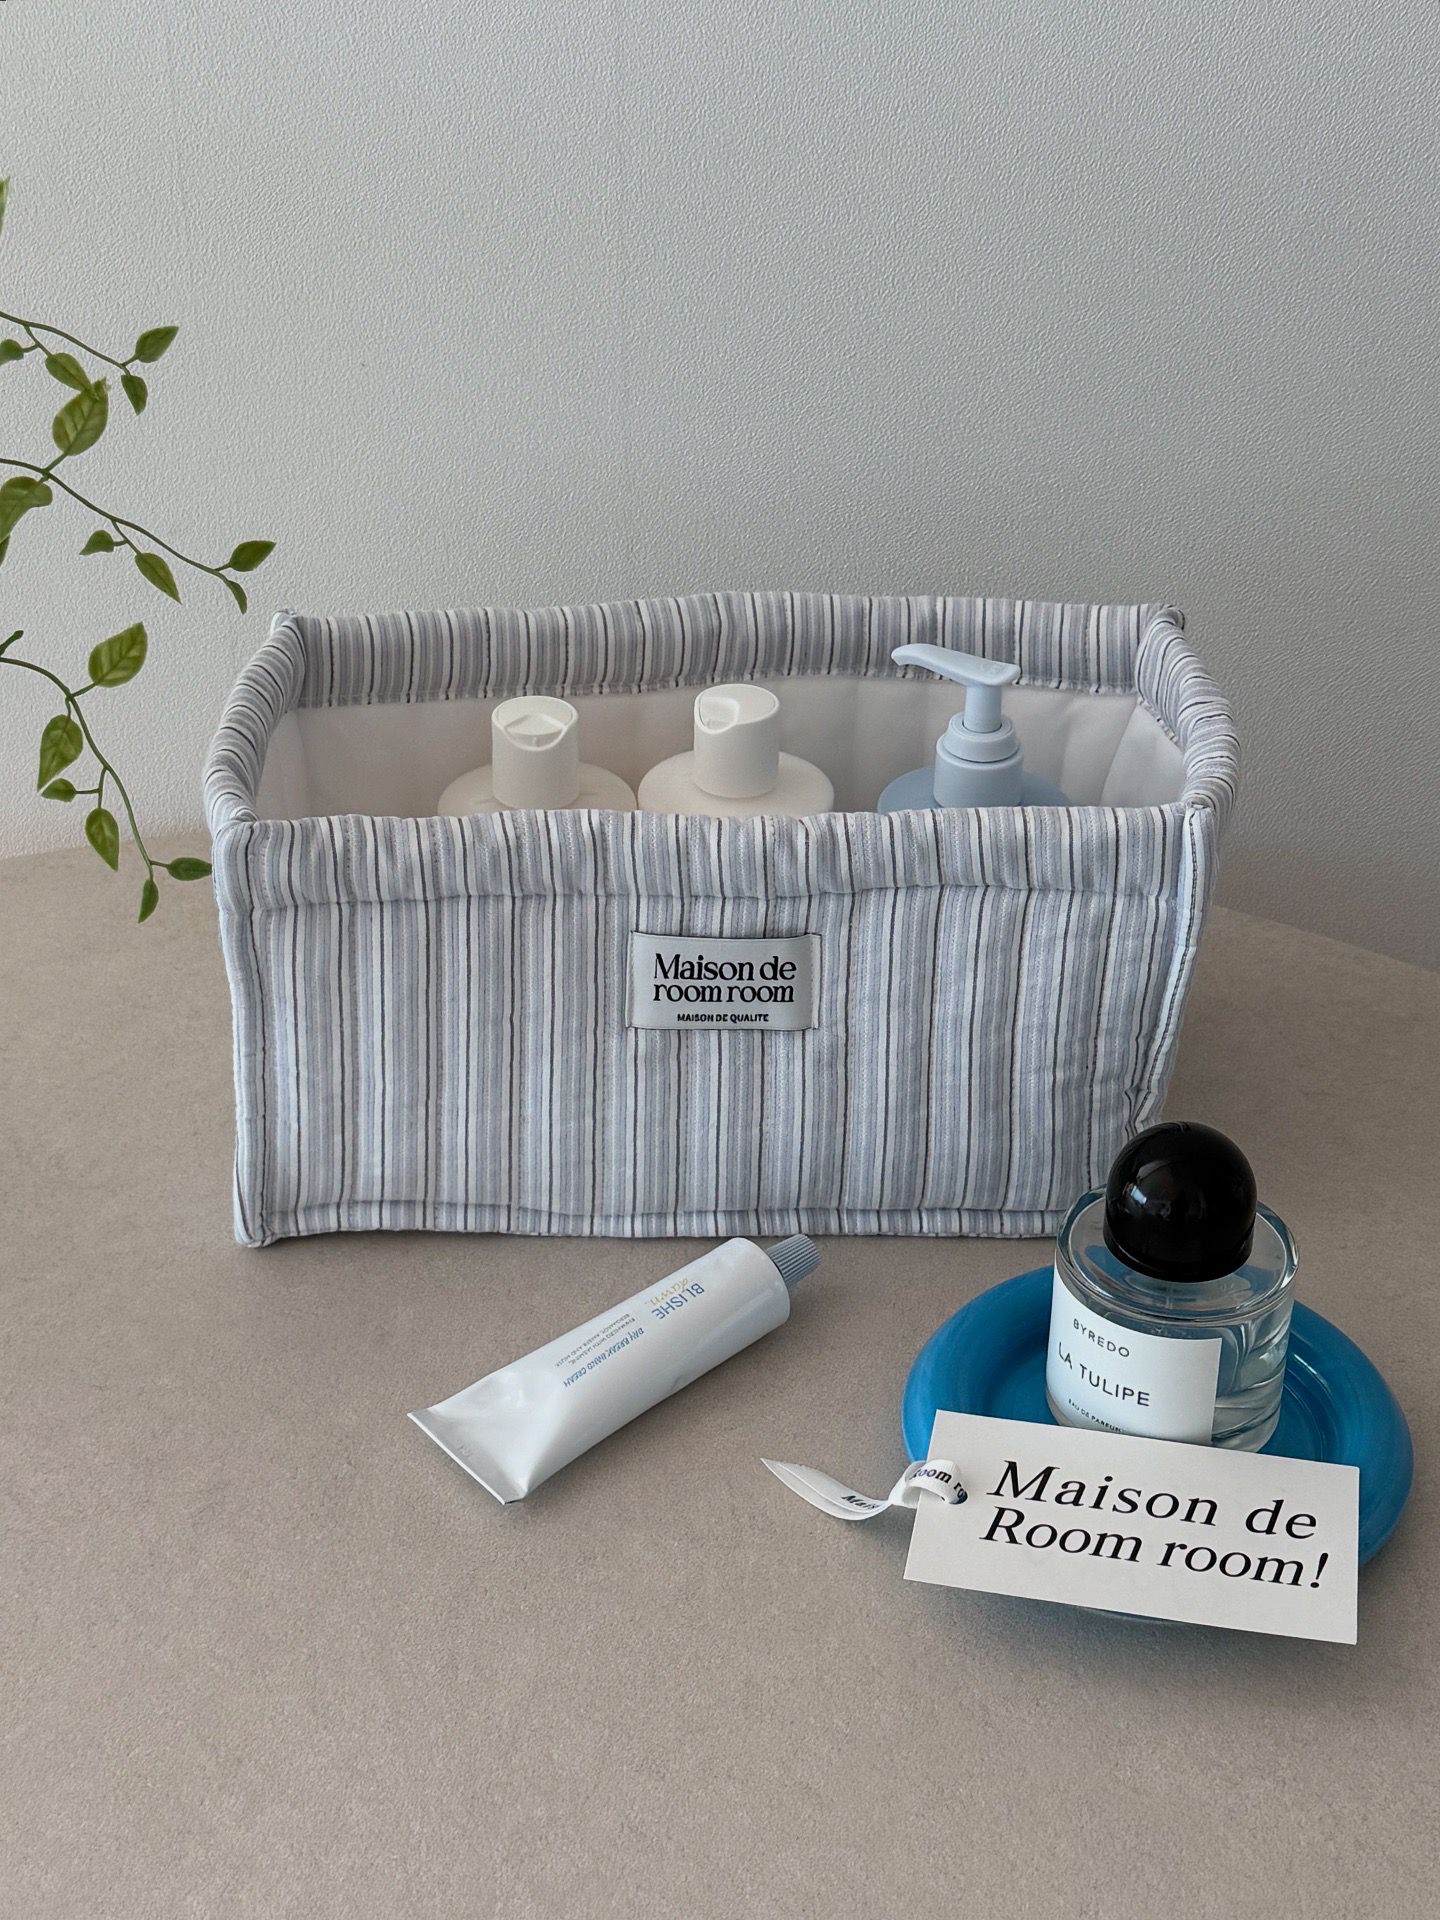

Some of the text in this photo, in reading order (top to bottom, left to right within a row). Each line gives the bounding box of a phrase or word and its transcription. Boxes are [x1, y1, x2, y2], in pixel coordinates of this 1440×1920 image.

[654, 953, 797, 981] Maison de
[653, 983, 794, 1003] room room
[677, 1013, 769, 1024] MAISON DE QUALITE
[651, 1283, 705, 1320] BLISHE
[1073, 1318, 1130, 1358] BYREDO
[1058, 1341, 1150, 1407] LA TULIPE
[986, 1460, 1317, 1539] Maison de
[979, 1505, 1329, 1589] Room room!
